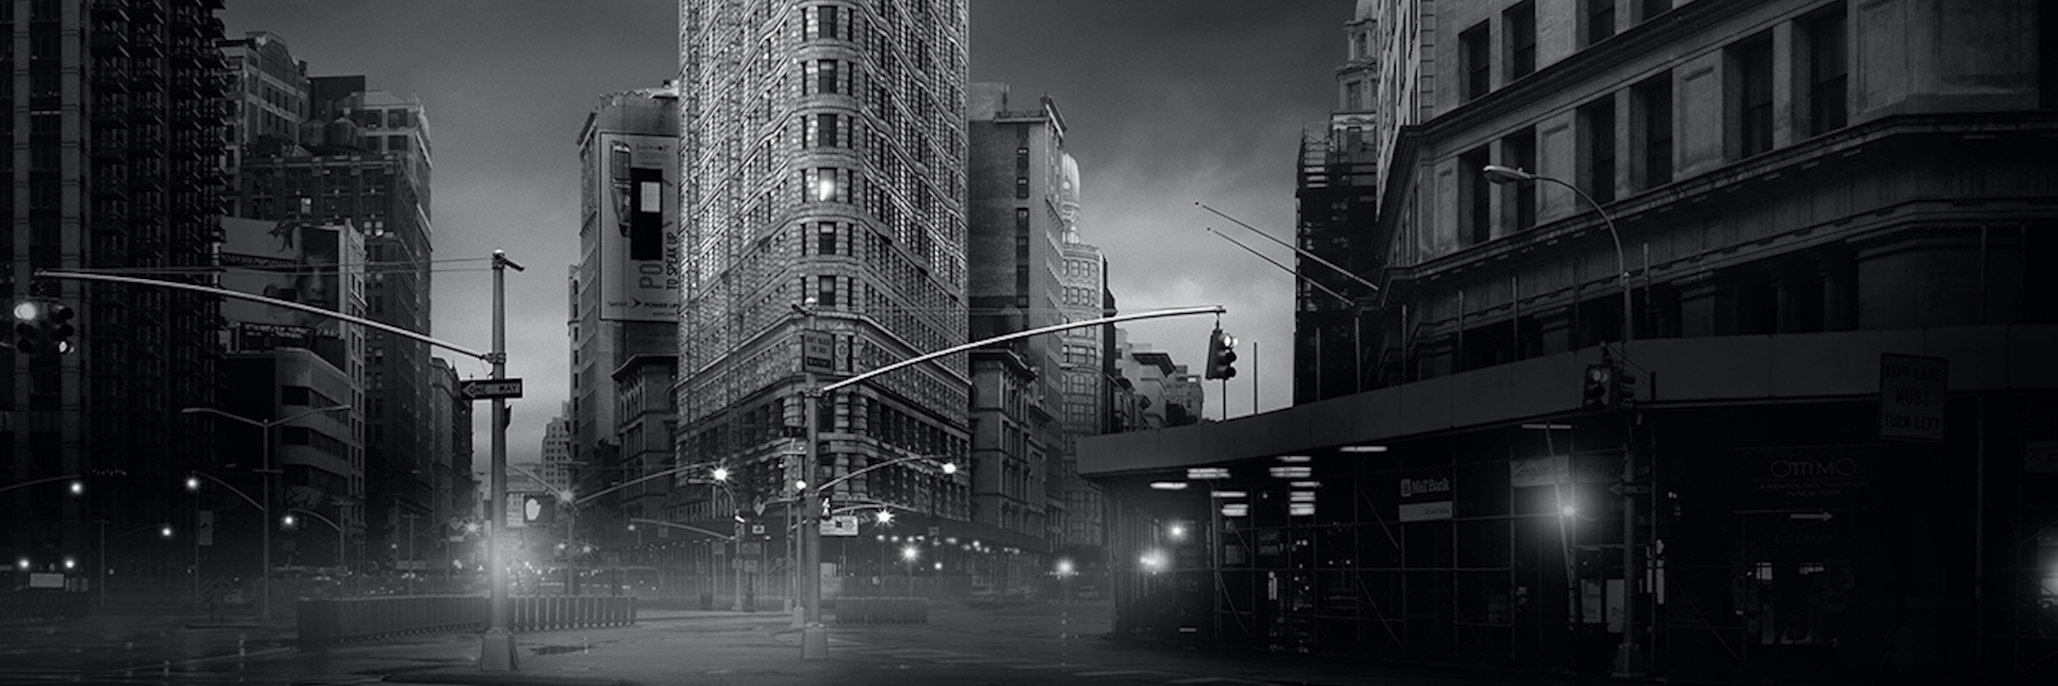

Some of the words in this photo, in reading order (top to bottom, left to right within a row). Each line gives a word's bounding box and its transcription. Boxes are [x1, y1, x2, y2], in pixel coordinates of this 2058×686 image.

[666, 231, 677, 244] UP
[666, 247, 678, 276] SPEAK
[666, 278, 678, 290] TO
[1887, 365, 1910, 378] LEFT
[1914, 367, 1944, 382] LANE
[469, 384, 486, 395] ONE
[498, 383, 519, 394] WAY
[1895, 388, 1930, 407] MUST
[1884, 414, 1911, 428] TURN
[1914, 416, 1940, 430] LEFT
[1770, 457, 1857, 478] OTTIMO
